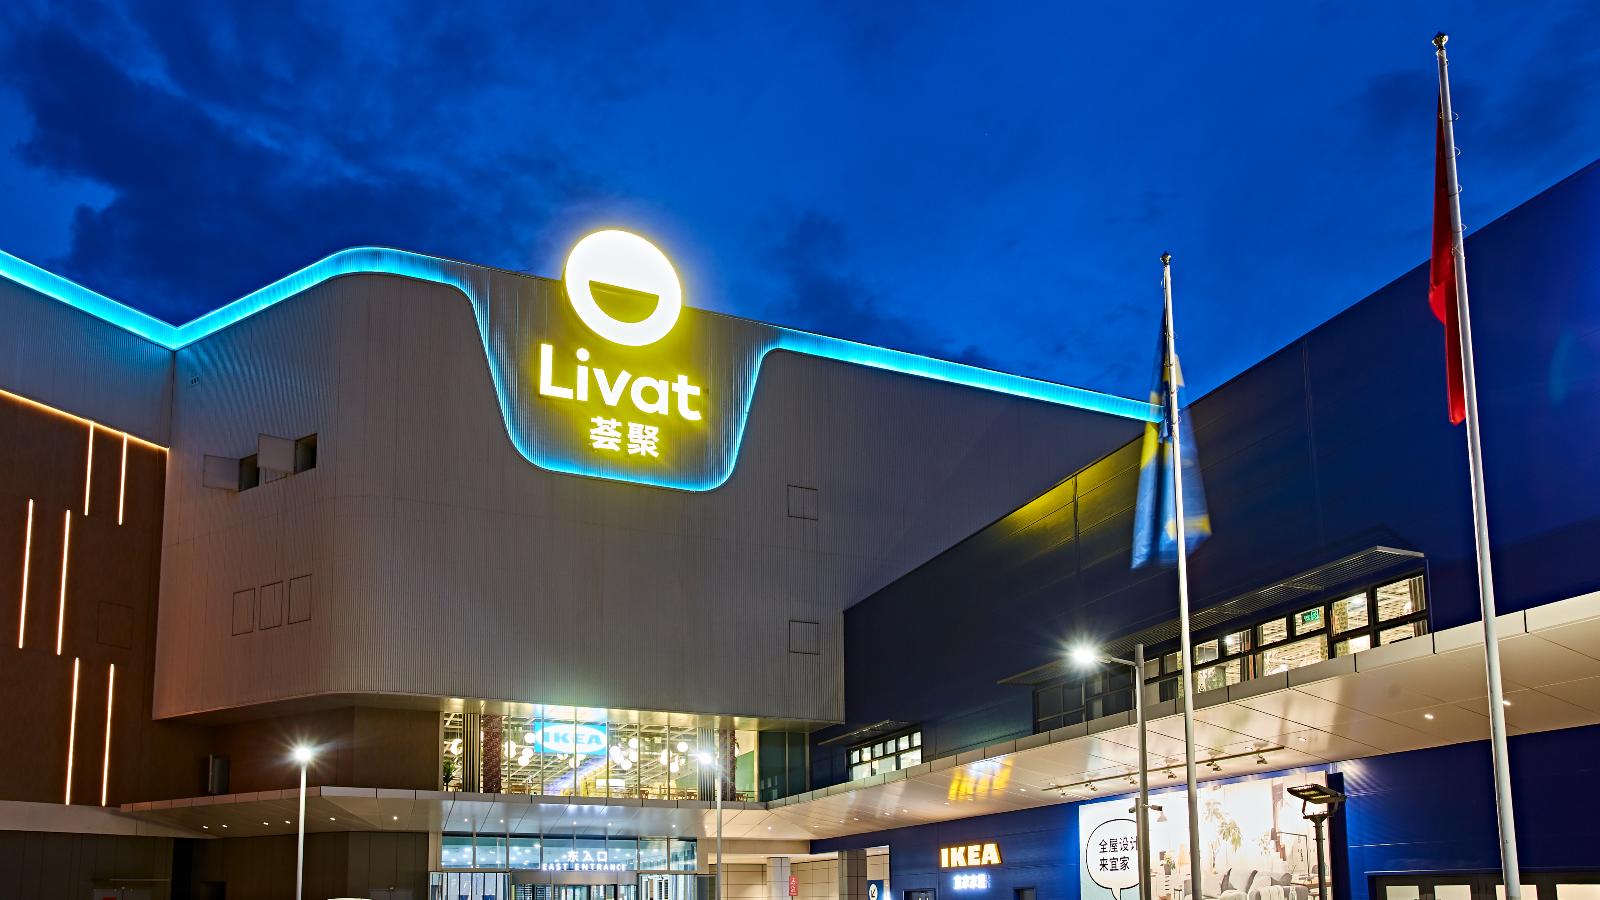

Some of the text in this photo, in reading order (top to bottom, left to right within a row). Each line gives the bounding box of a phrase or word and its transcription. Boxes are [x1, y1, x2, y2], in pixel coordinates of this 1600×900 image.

[539, 343, 702, 421] Livat
[589, 416, 660, 458] 荟聚
[543, 731, 602, 745] IKEA
[567, 850, 608, 862] 东入口
[940, 843, 1002, 868] IKEA
[542, 863, 626, 872] EAST ENTRANCE
[1099, 856, 1130, 871] 来宜家
